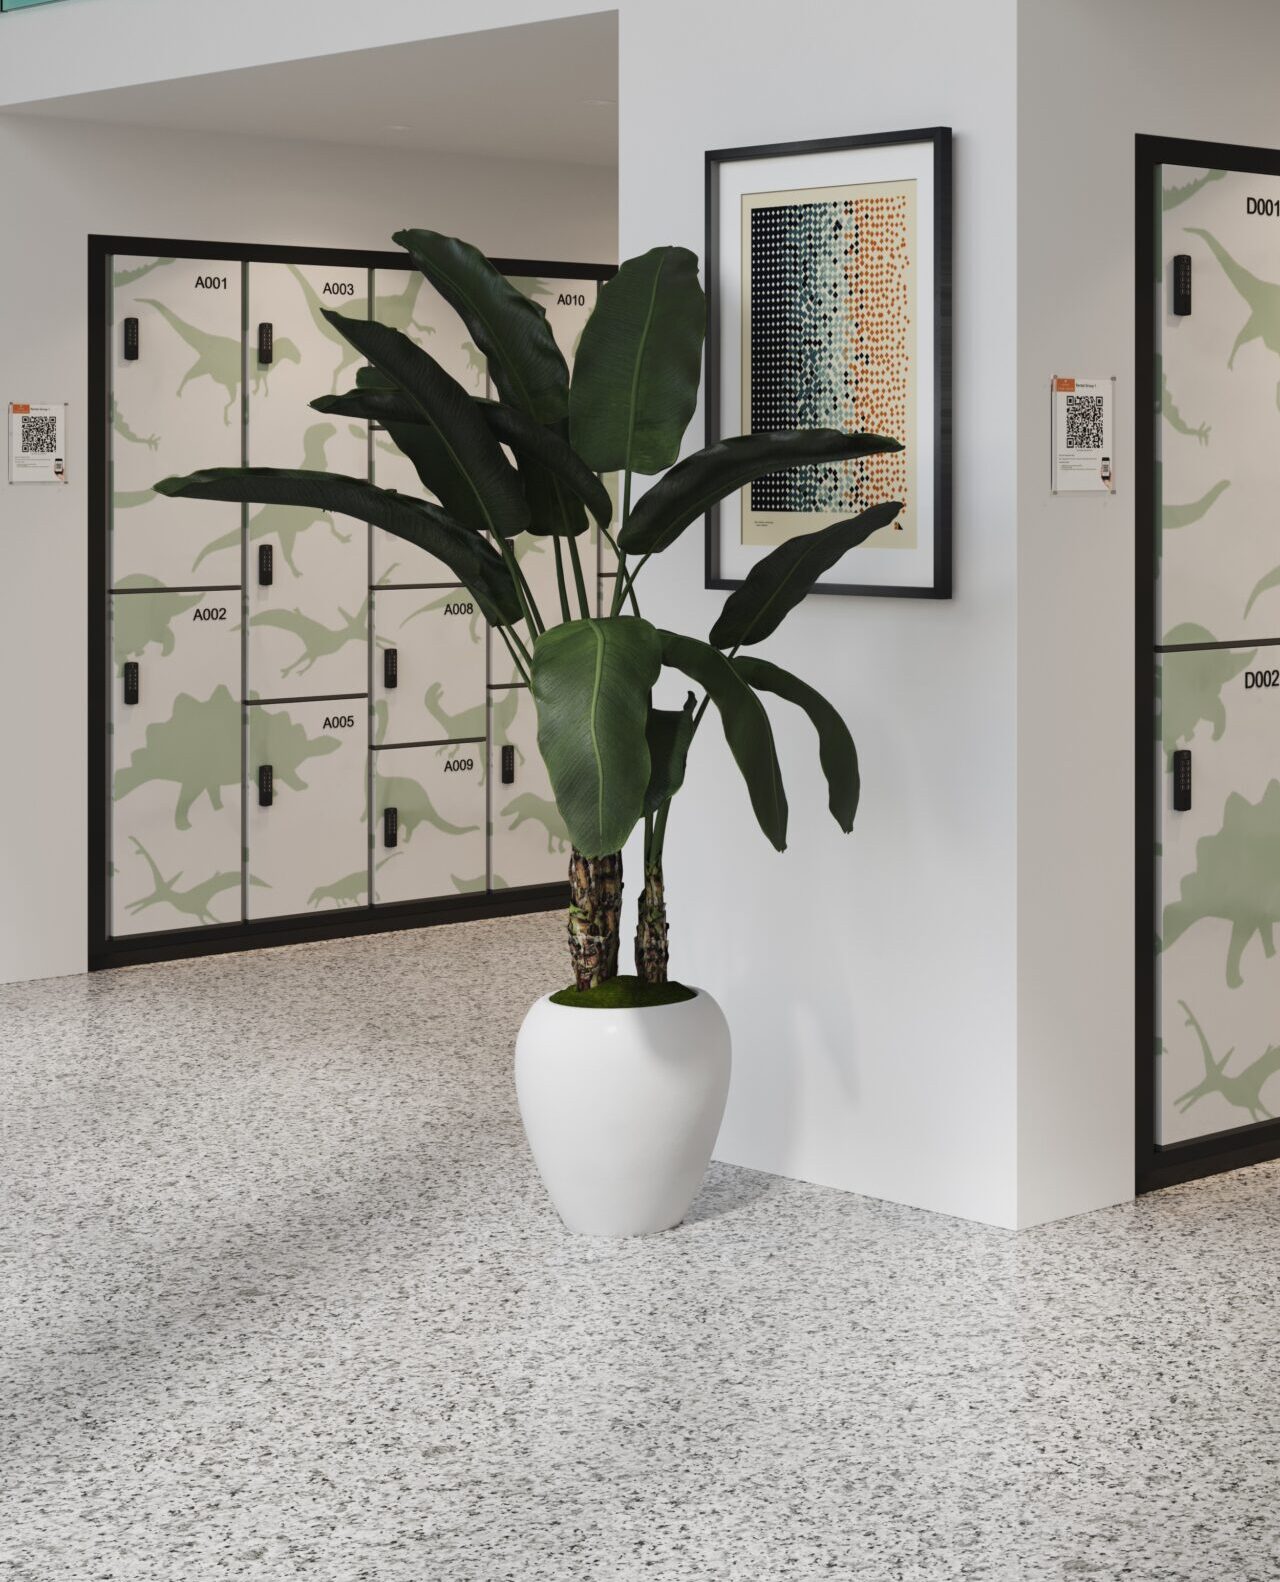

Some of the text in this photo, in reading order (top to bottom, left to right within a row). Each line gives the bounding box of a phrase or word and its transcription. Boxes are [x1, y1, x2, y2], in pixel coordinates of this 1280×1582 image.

[1246, 196, 1280, 217] D001
[194, 276, 229, 291] A001
[322, 282, 354, 296] A003
[557, 293, 585, 307] A010
[192, 607, 227, 621] A002
[443, 601, 475, 616] A008
[1244, 669, 1280, 689] D002
[322, 715, 355, 729] A005
[443, 758, 474, 773] A009
